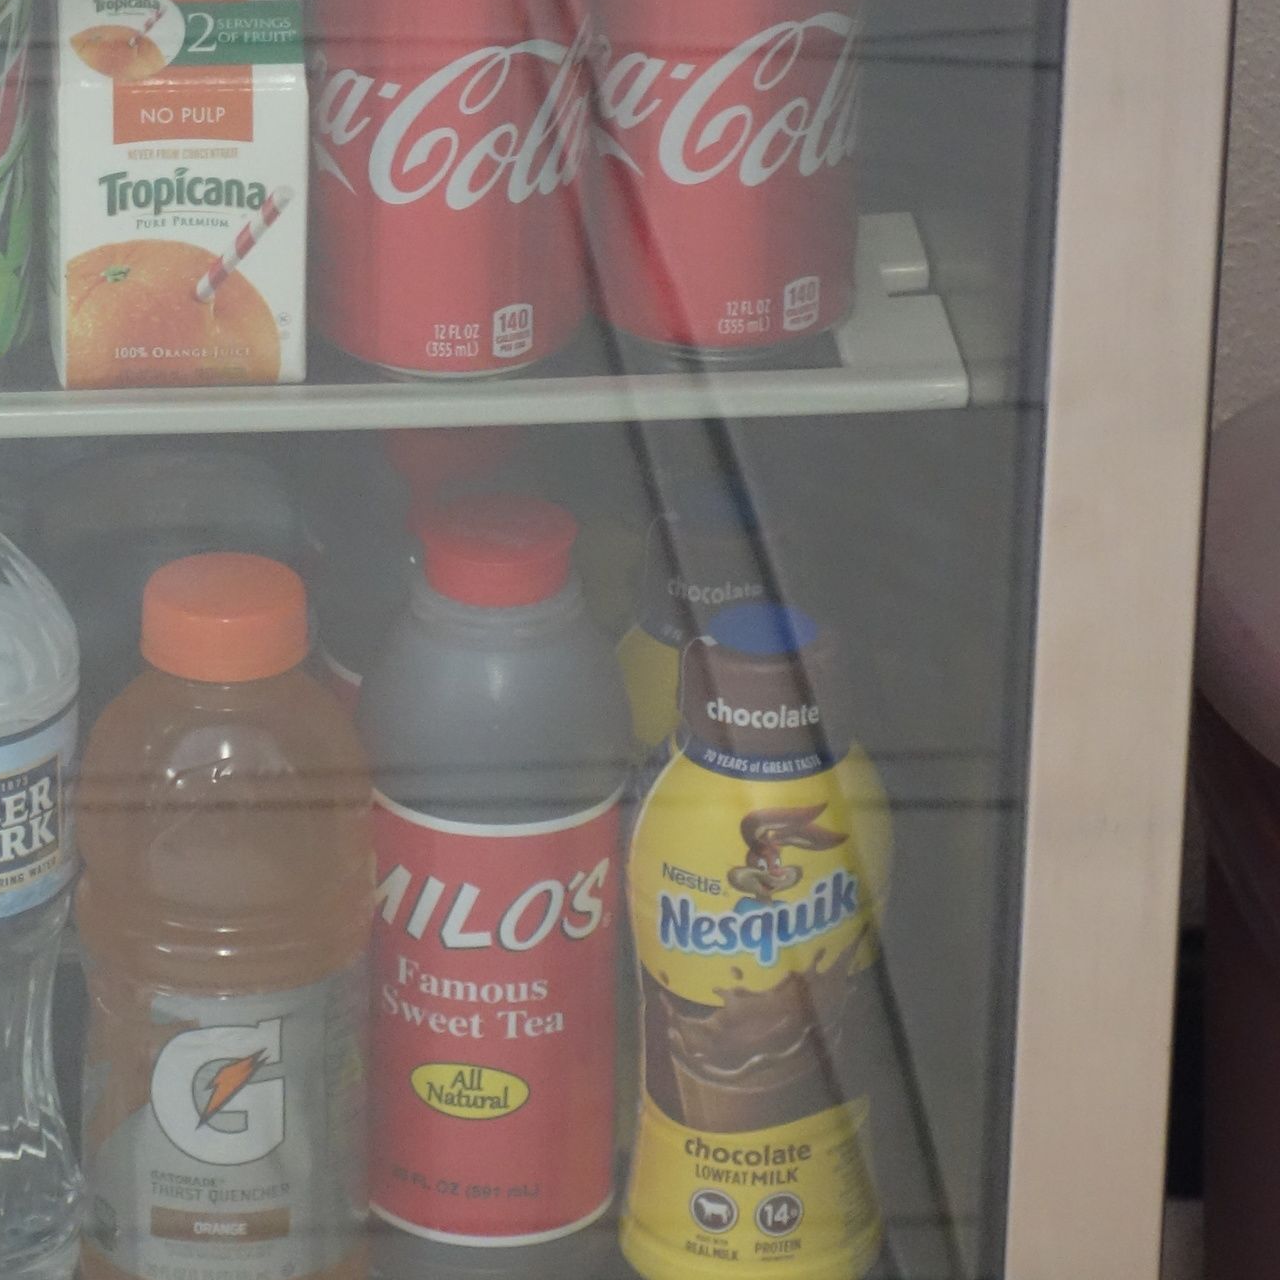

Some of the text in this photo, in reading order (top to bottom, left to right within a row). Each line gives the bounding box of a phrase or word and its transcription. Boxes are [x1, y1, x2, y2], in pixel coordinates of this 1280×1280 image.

[187, 12, 291, 53] 2 SERVINGS
[218, 31, 238, 43] OF
[140, 107, 226, 124] NO PULP
[99, 167, 266, 216] Tropicana
[136, 216, 230, 229] PURE PREMIUM
[789, 281, 817, 310] 140
[433, 323, 480, 340] 12 FL OZ
[499, 308, 529, 334] 140
[114, 347, 149, 359] 100%
[425, 341, 452, 358] (355
[455, 340, 479, 357] mL)
[667, 580, 762, 605] chocolate
[706, 697, 820, 729] chocolate
[716, 752, 748, 772] YEARS
[762, 758, 794, 773] GREAT
[660, 872, 856, 964] Nesquik
[397, 954, 550, 1004] Famous
[381, 983, 565, 1040] Sweet Tea
[151, 1016, 286, 1166] G
[451, 1070, 483, 1092] All
[426, 1082, 511, 1110] Natural
[684, 1136, 812, 1167] chocolate
[695, 1163, 799, 1186] LOWFAT MILK
[150, 1181, 291, 1204] THIRST QUENCHER
[437, 1178, 460, 1196] OZ
[193, 1221, 248, 1236] ORANGE
[754, 1238, 802, 1255] PROTEIN
